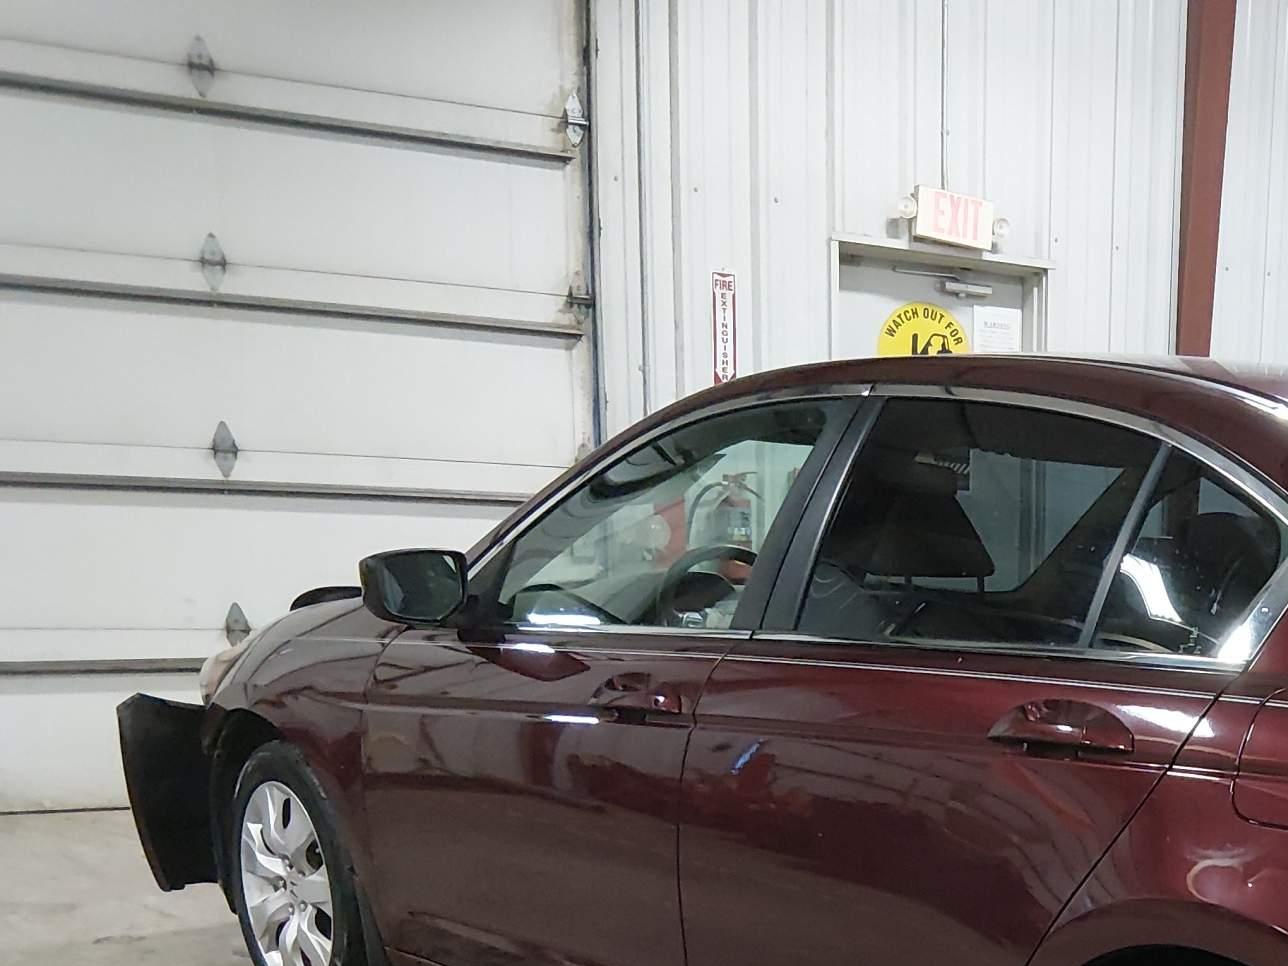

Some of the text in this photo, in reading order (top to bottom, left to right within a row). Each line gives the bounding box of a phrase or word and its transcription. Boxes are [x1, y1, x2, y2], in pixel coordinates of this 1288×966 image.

[934, 191, 983, 241] EXIT
[714, 279, 733, 291] FIRE
[720, 292, 729, 381] EXTINGUISHER
[884, 307, 919, 338] WATCH
[922, 307, 945, 324] OUT
[944, 321, 964, 346] FOR
